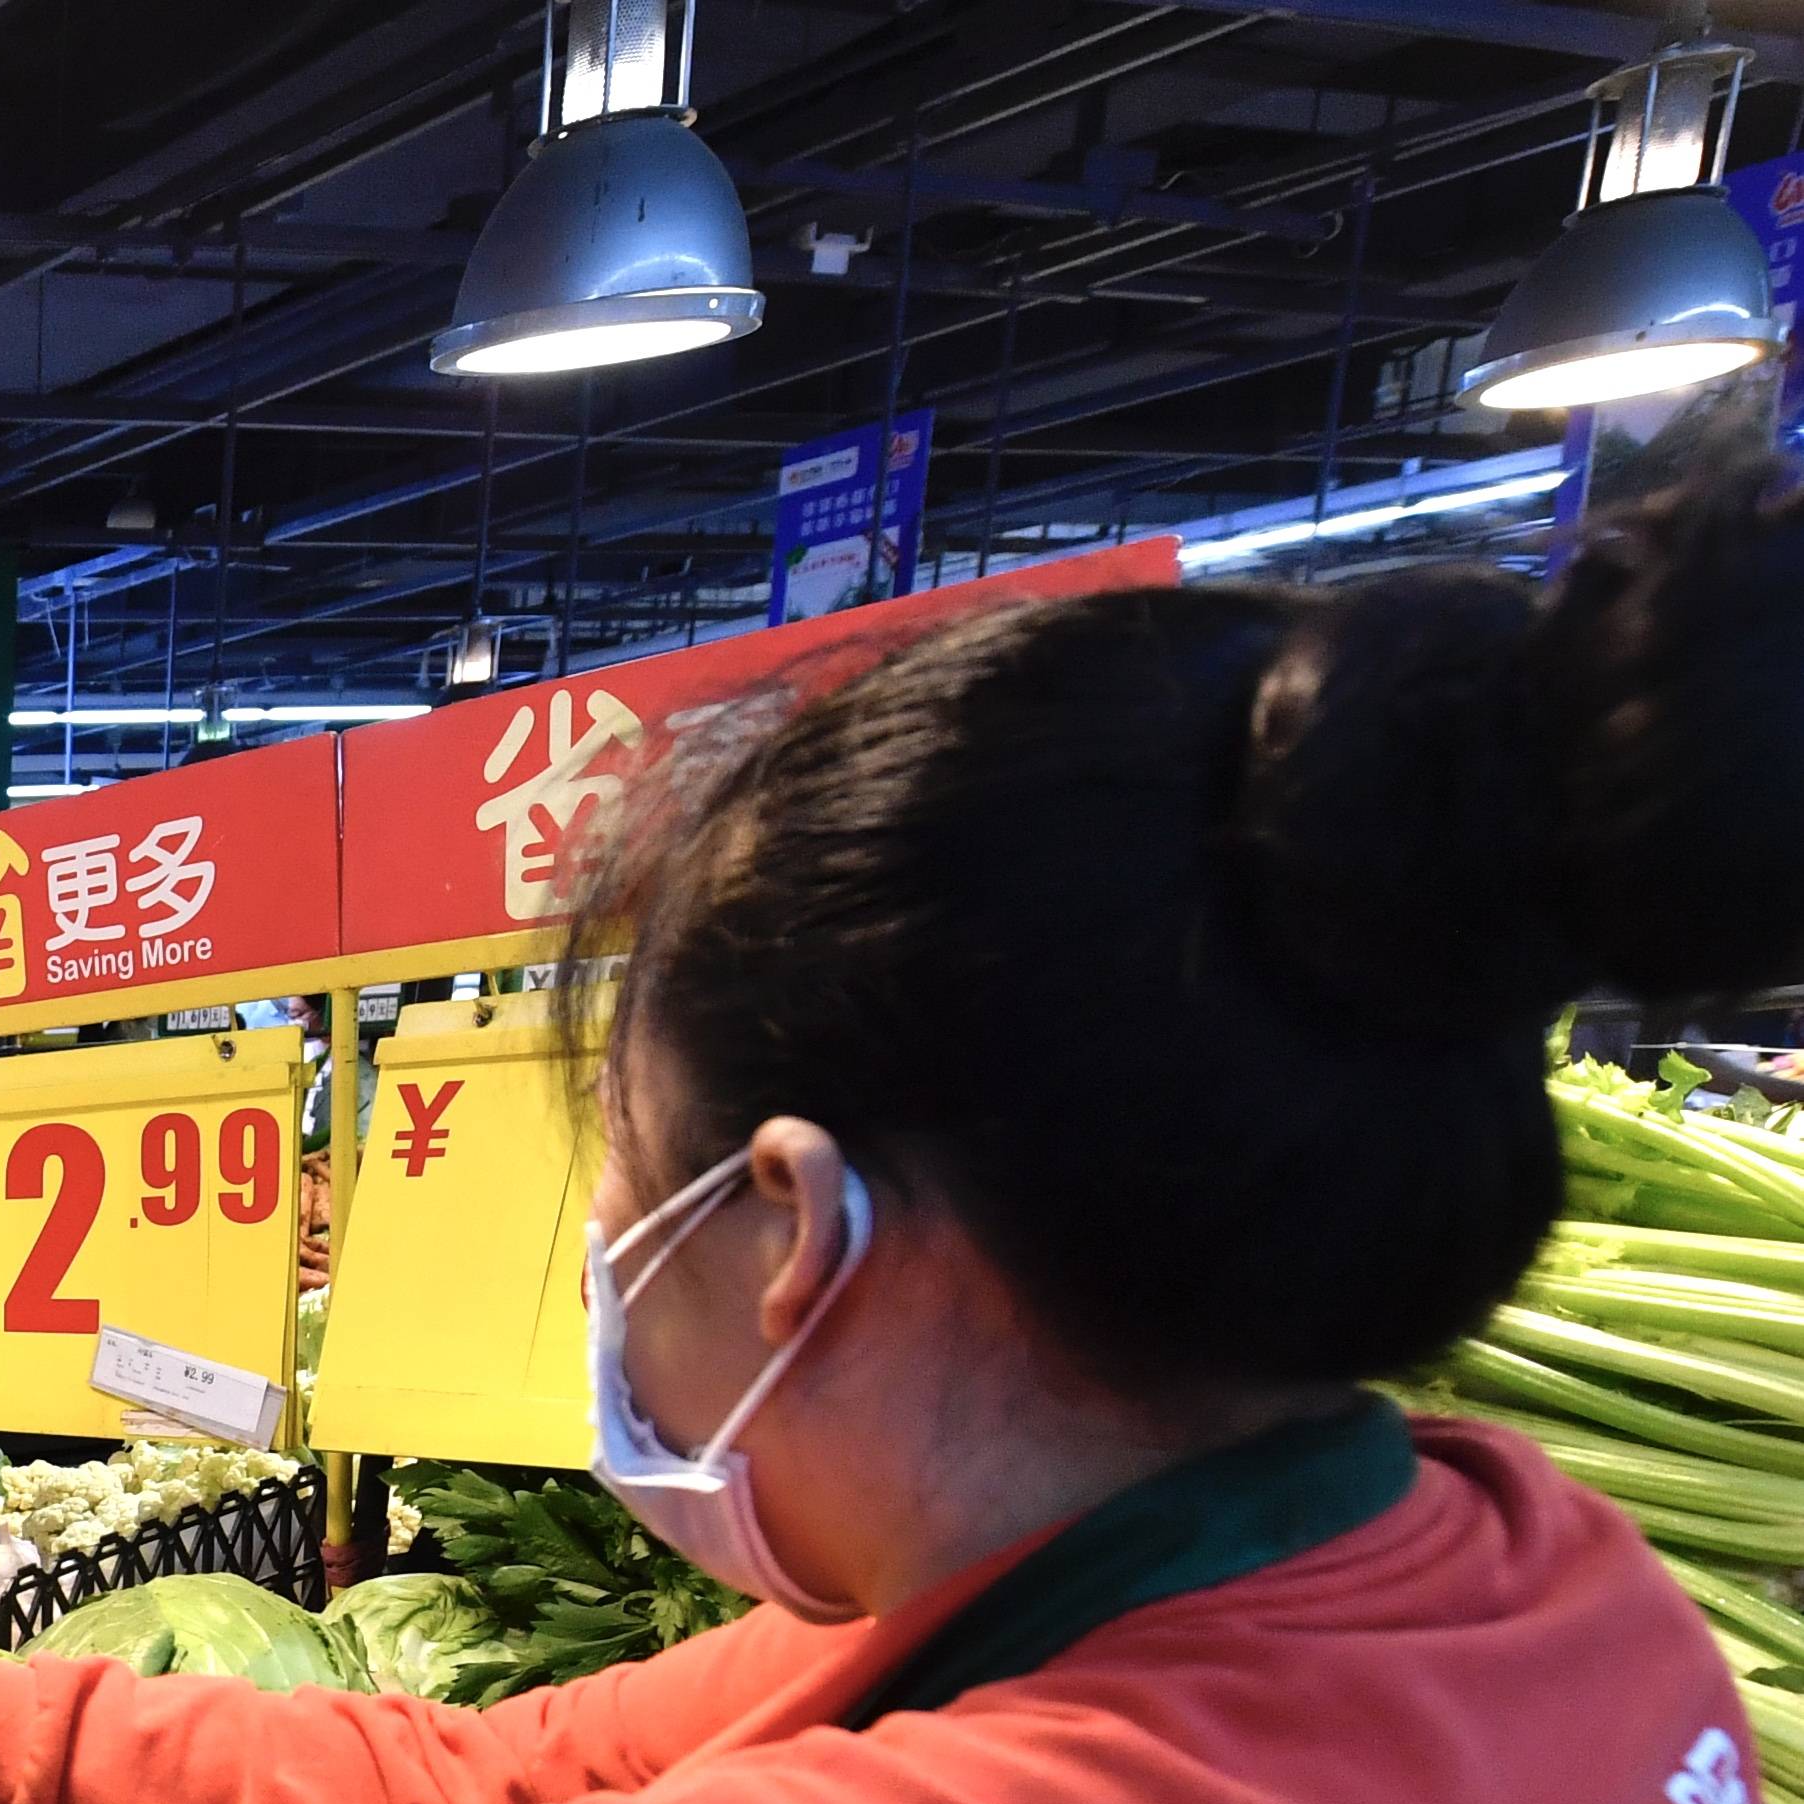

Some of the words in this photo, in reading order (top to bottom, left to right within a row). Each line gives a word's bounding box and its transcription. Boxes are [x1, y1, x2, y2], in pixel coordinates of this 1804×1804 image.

[45, 947, 135, 984] Saving
[142, 936, 213, 969] More
[391, 1080, 466, 1177] ¥
[4, 1107, 281, 1334] 2.99
